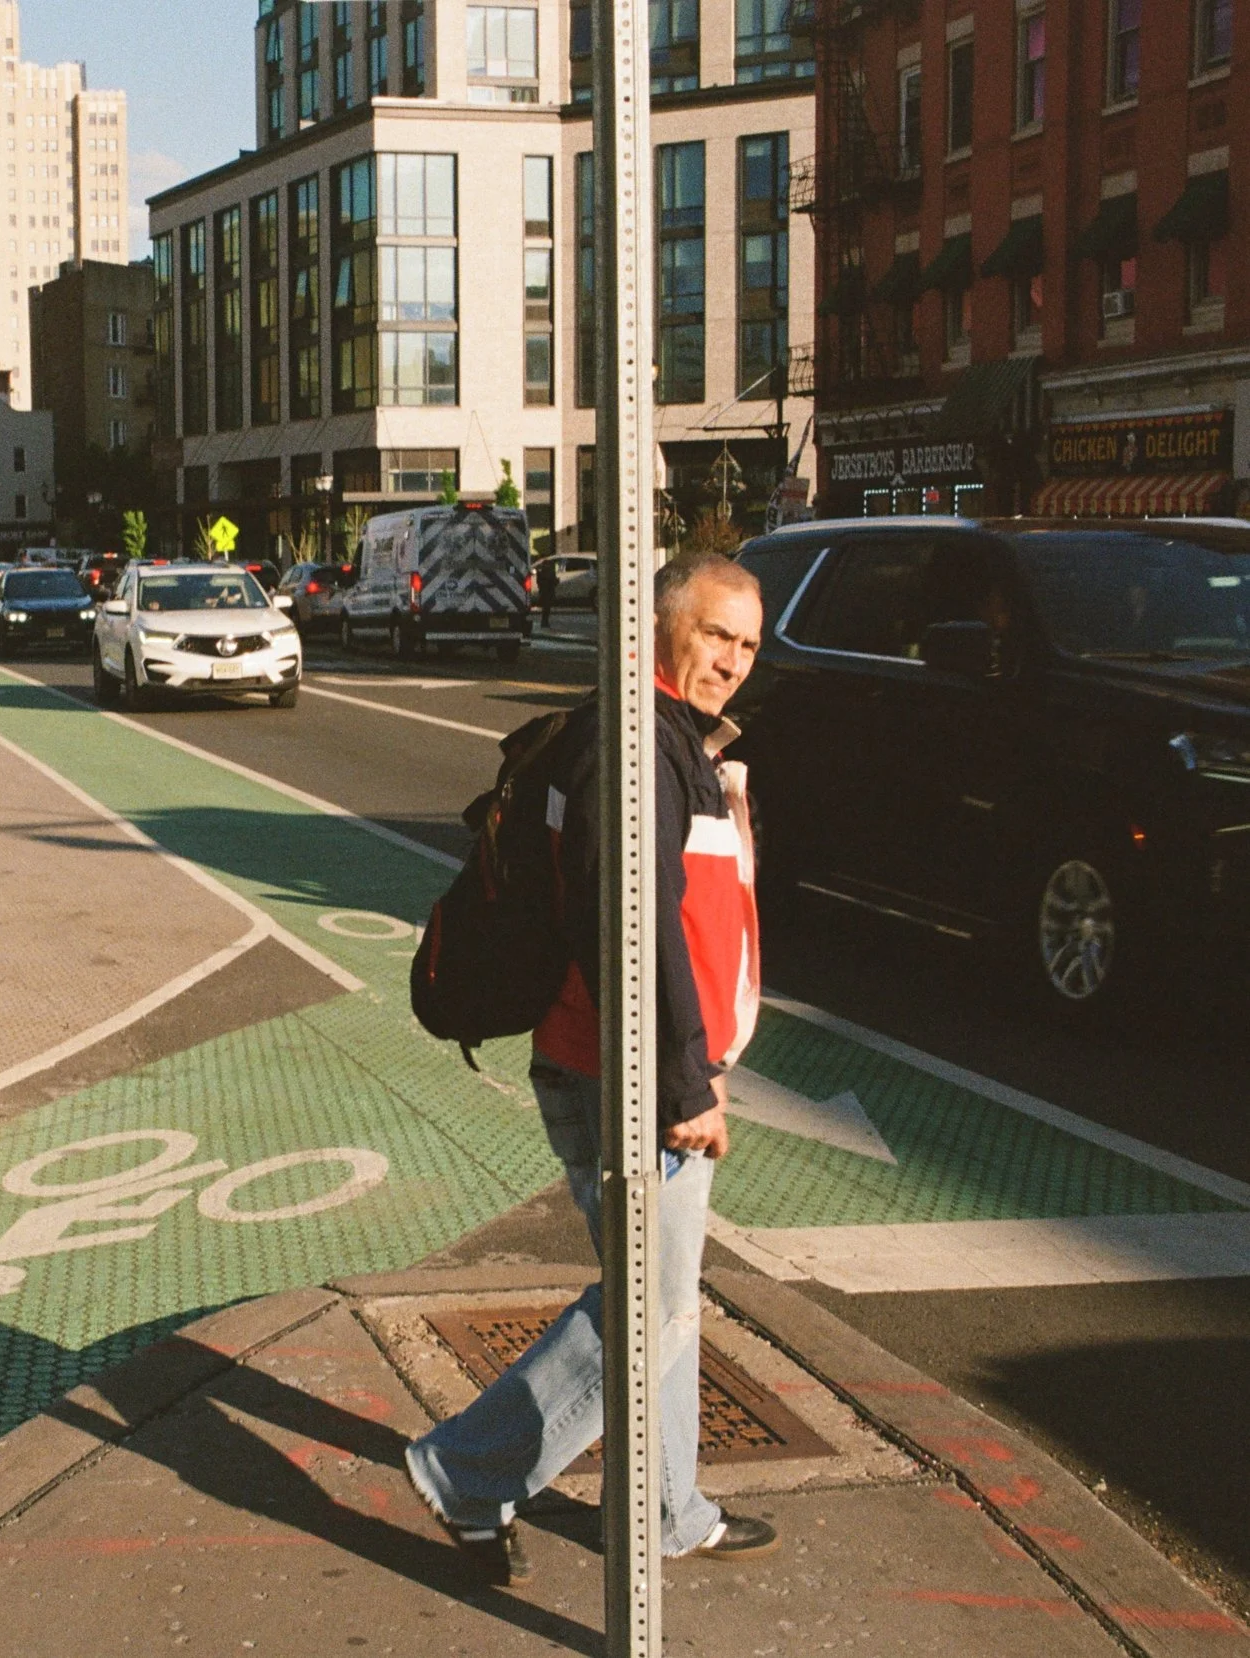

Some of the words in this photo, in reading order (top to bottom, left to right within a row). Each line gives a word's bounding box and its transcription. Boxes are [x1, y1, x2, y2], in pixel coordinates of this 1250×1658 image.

[831, 449, 895, 481] JERSEYBOYS
[901, 442, 975, 475] BARBERSHOP
[1052, 435, 1118, 463] CHICKEN
[1145, 427, 1221, 459] DELIGHT
